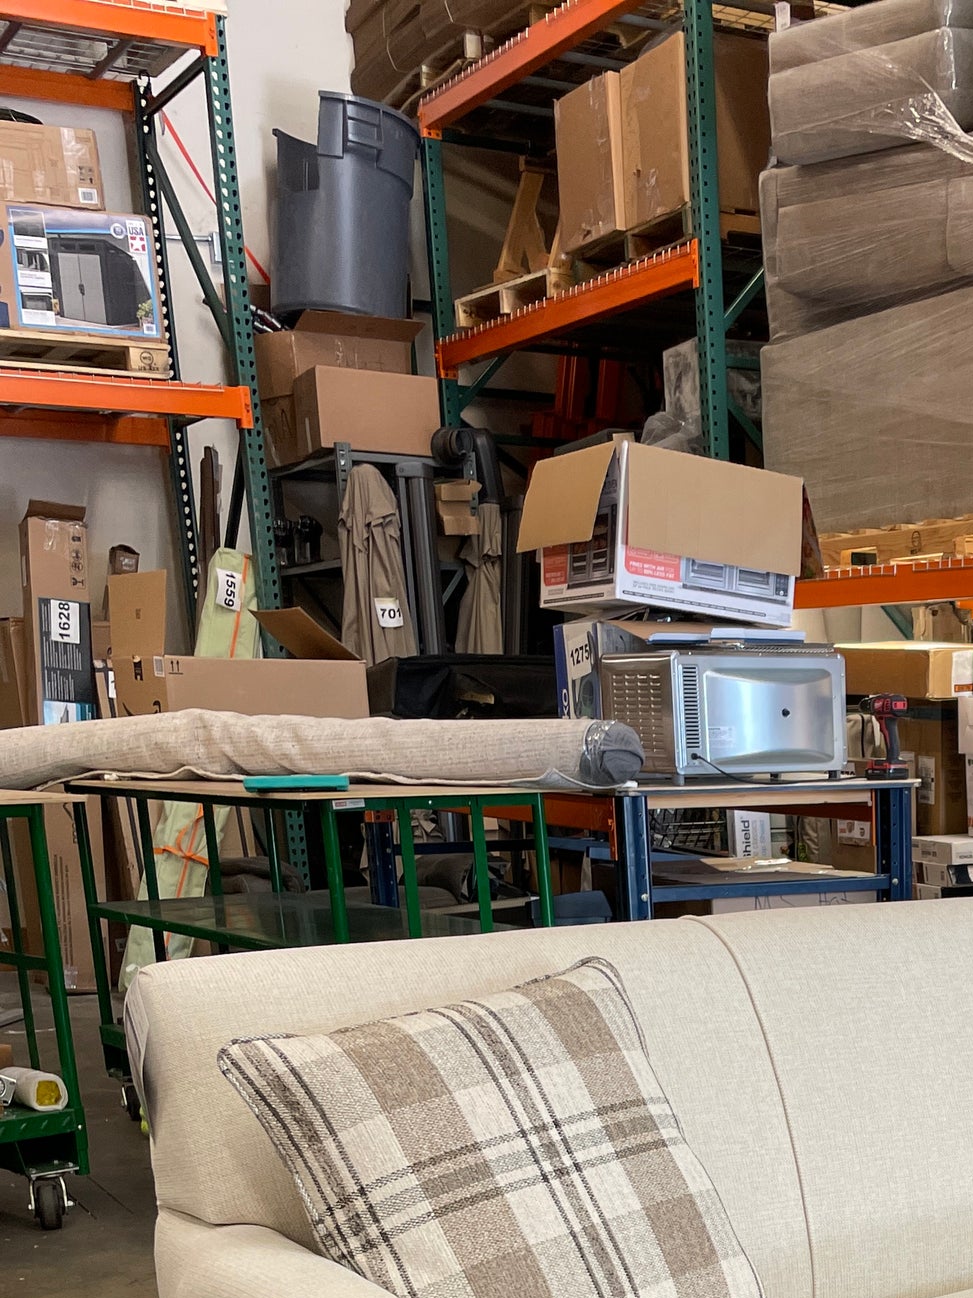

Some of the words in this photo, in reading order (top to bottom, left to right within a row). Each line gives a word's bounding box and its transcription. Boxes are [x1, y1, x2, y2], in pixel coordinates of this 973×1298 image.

[128, 226, 144, 236] USA
[224, 571, 236, 607] 1559
[58, 602, 70, 640] 1628
[380, 608, 401, 619] 701
[570, 644, 590, 666] 1275
